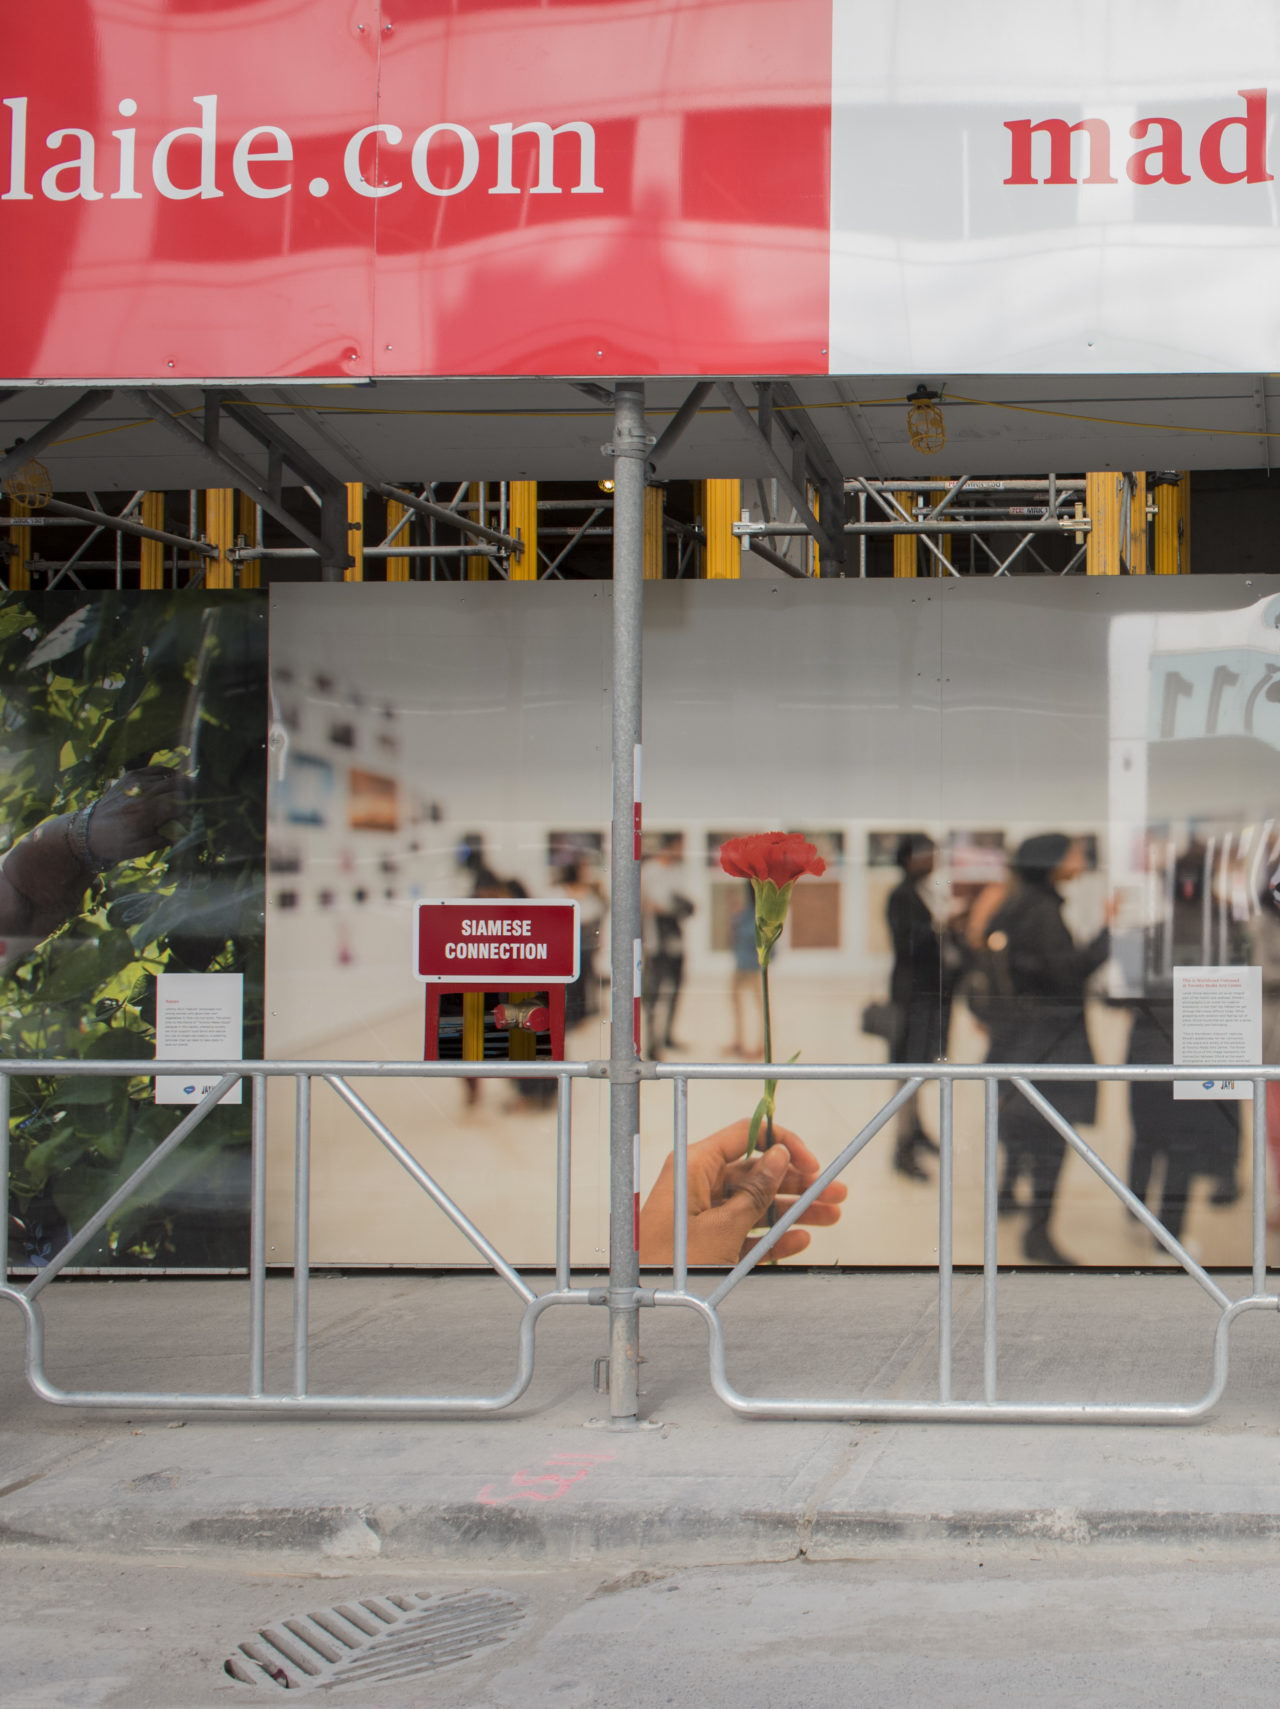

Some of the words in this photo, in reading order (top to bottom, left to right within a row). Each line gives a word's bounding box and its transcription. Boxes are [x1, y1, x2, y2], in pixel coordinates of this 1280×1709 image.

[2, 94, 605, 202] laide.com
[461, 919, 532, 936] SIAMESE
[445, 942, 548, 960] CONNECTION
